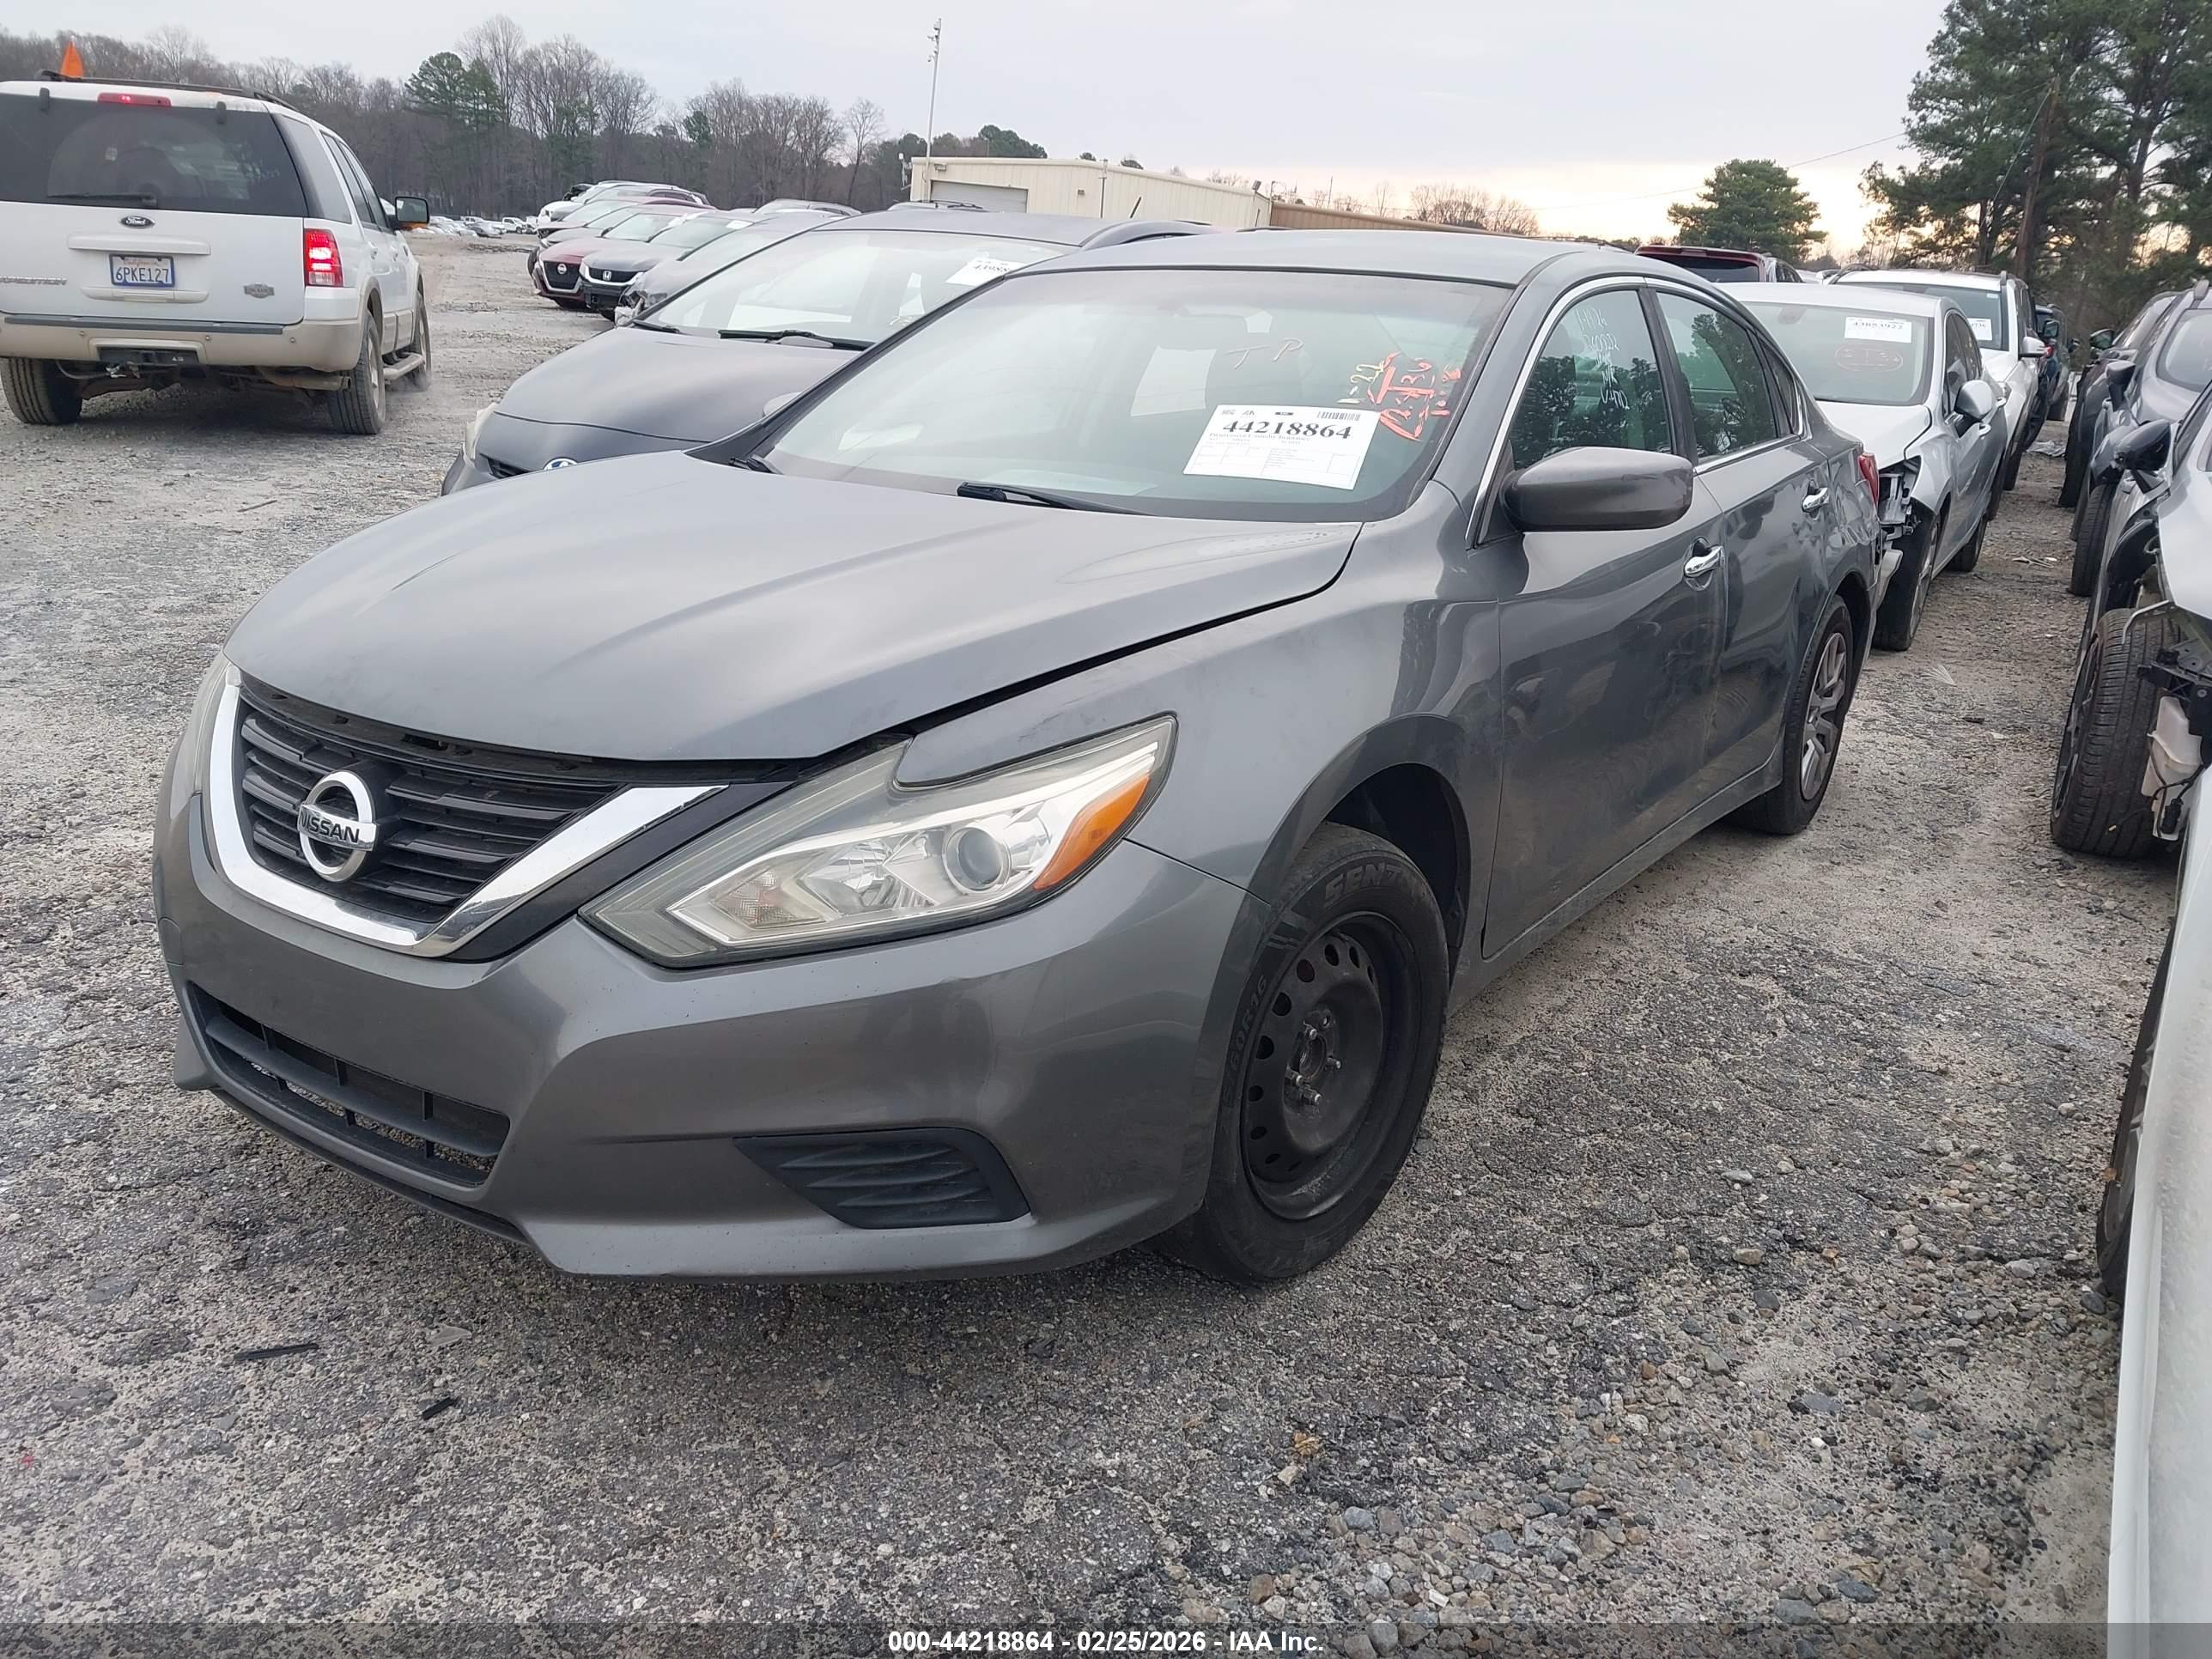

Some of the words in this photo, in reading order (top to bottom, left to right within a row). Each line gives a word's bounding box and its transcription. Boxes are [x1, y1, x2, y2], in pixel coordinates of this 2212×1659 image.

[115, 266, 169, 283] 6PKE127
[1222, 420, 1352, 440] 44218864
[299, 809, 360, 844] NISSAN
